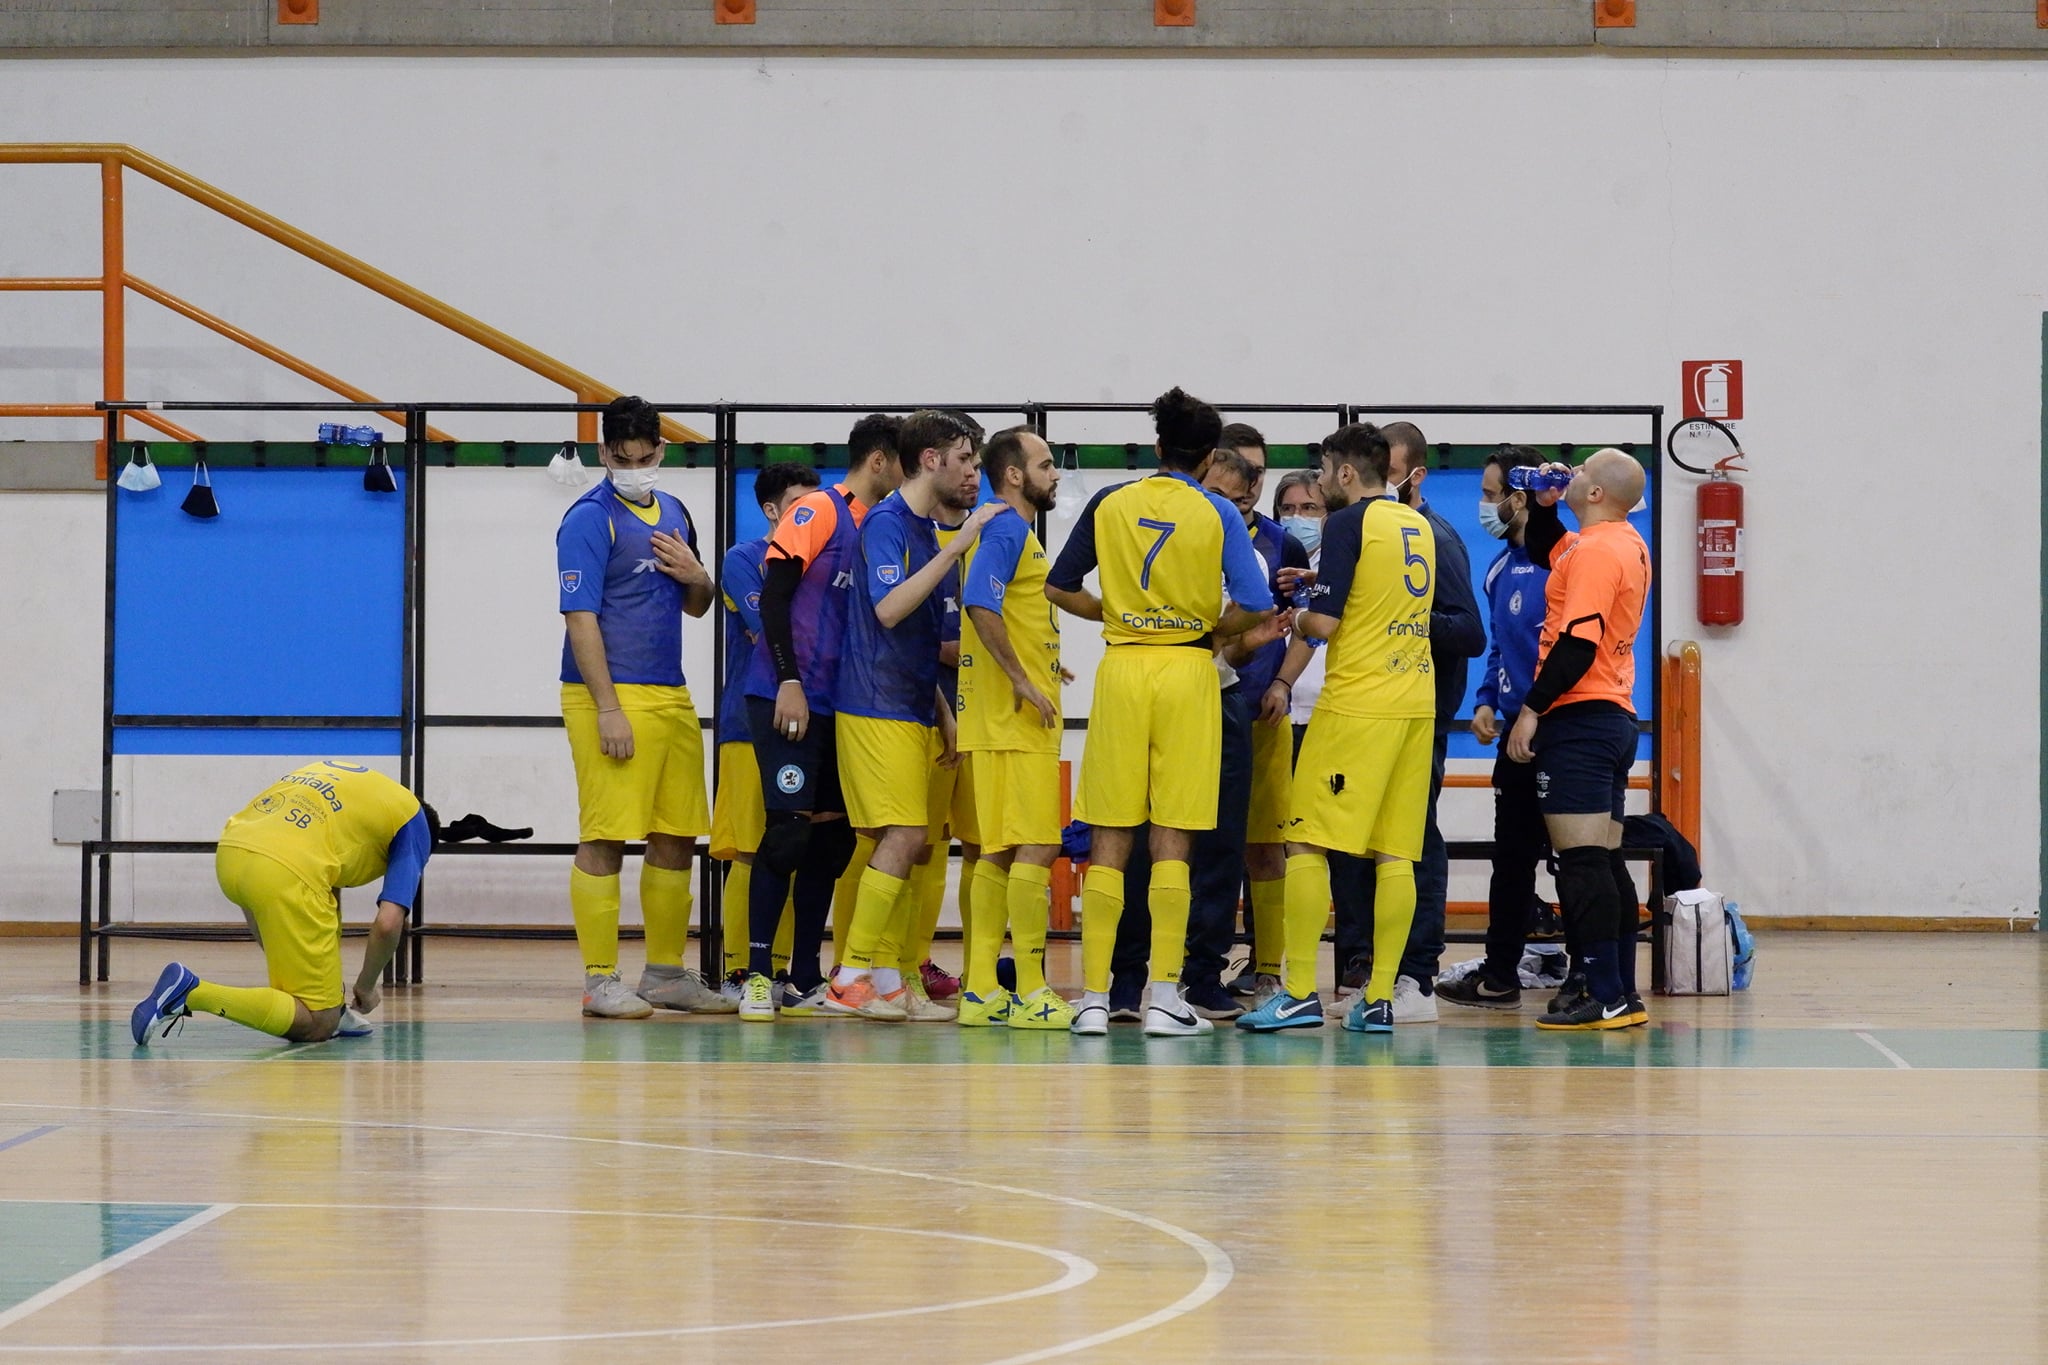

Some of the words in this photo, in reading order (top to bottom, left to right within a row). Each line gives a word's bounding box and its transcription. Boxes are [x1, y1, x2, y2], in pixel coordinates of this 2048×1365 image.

[1689, 422, 1736, 431] ESTINRE
[1137, 517, 1176, 591] 7
[1400, 527, 1431, 598] 5
[1121, 612, 1204, 632] Fontalba
[284, 808, 312, 829] SB
